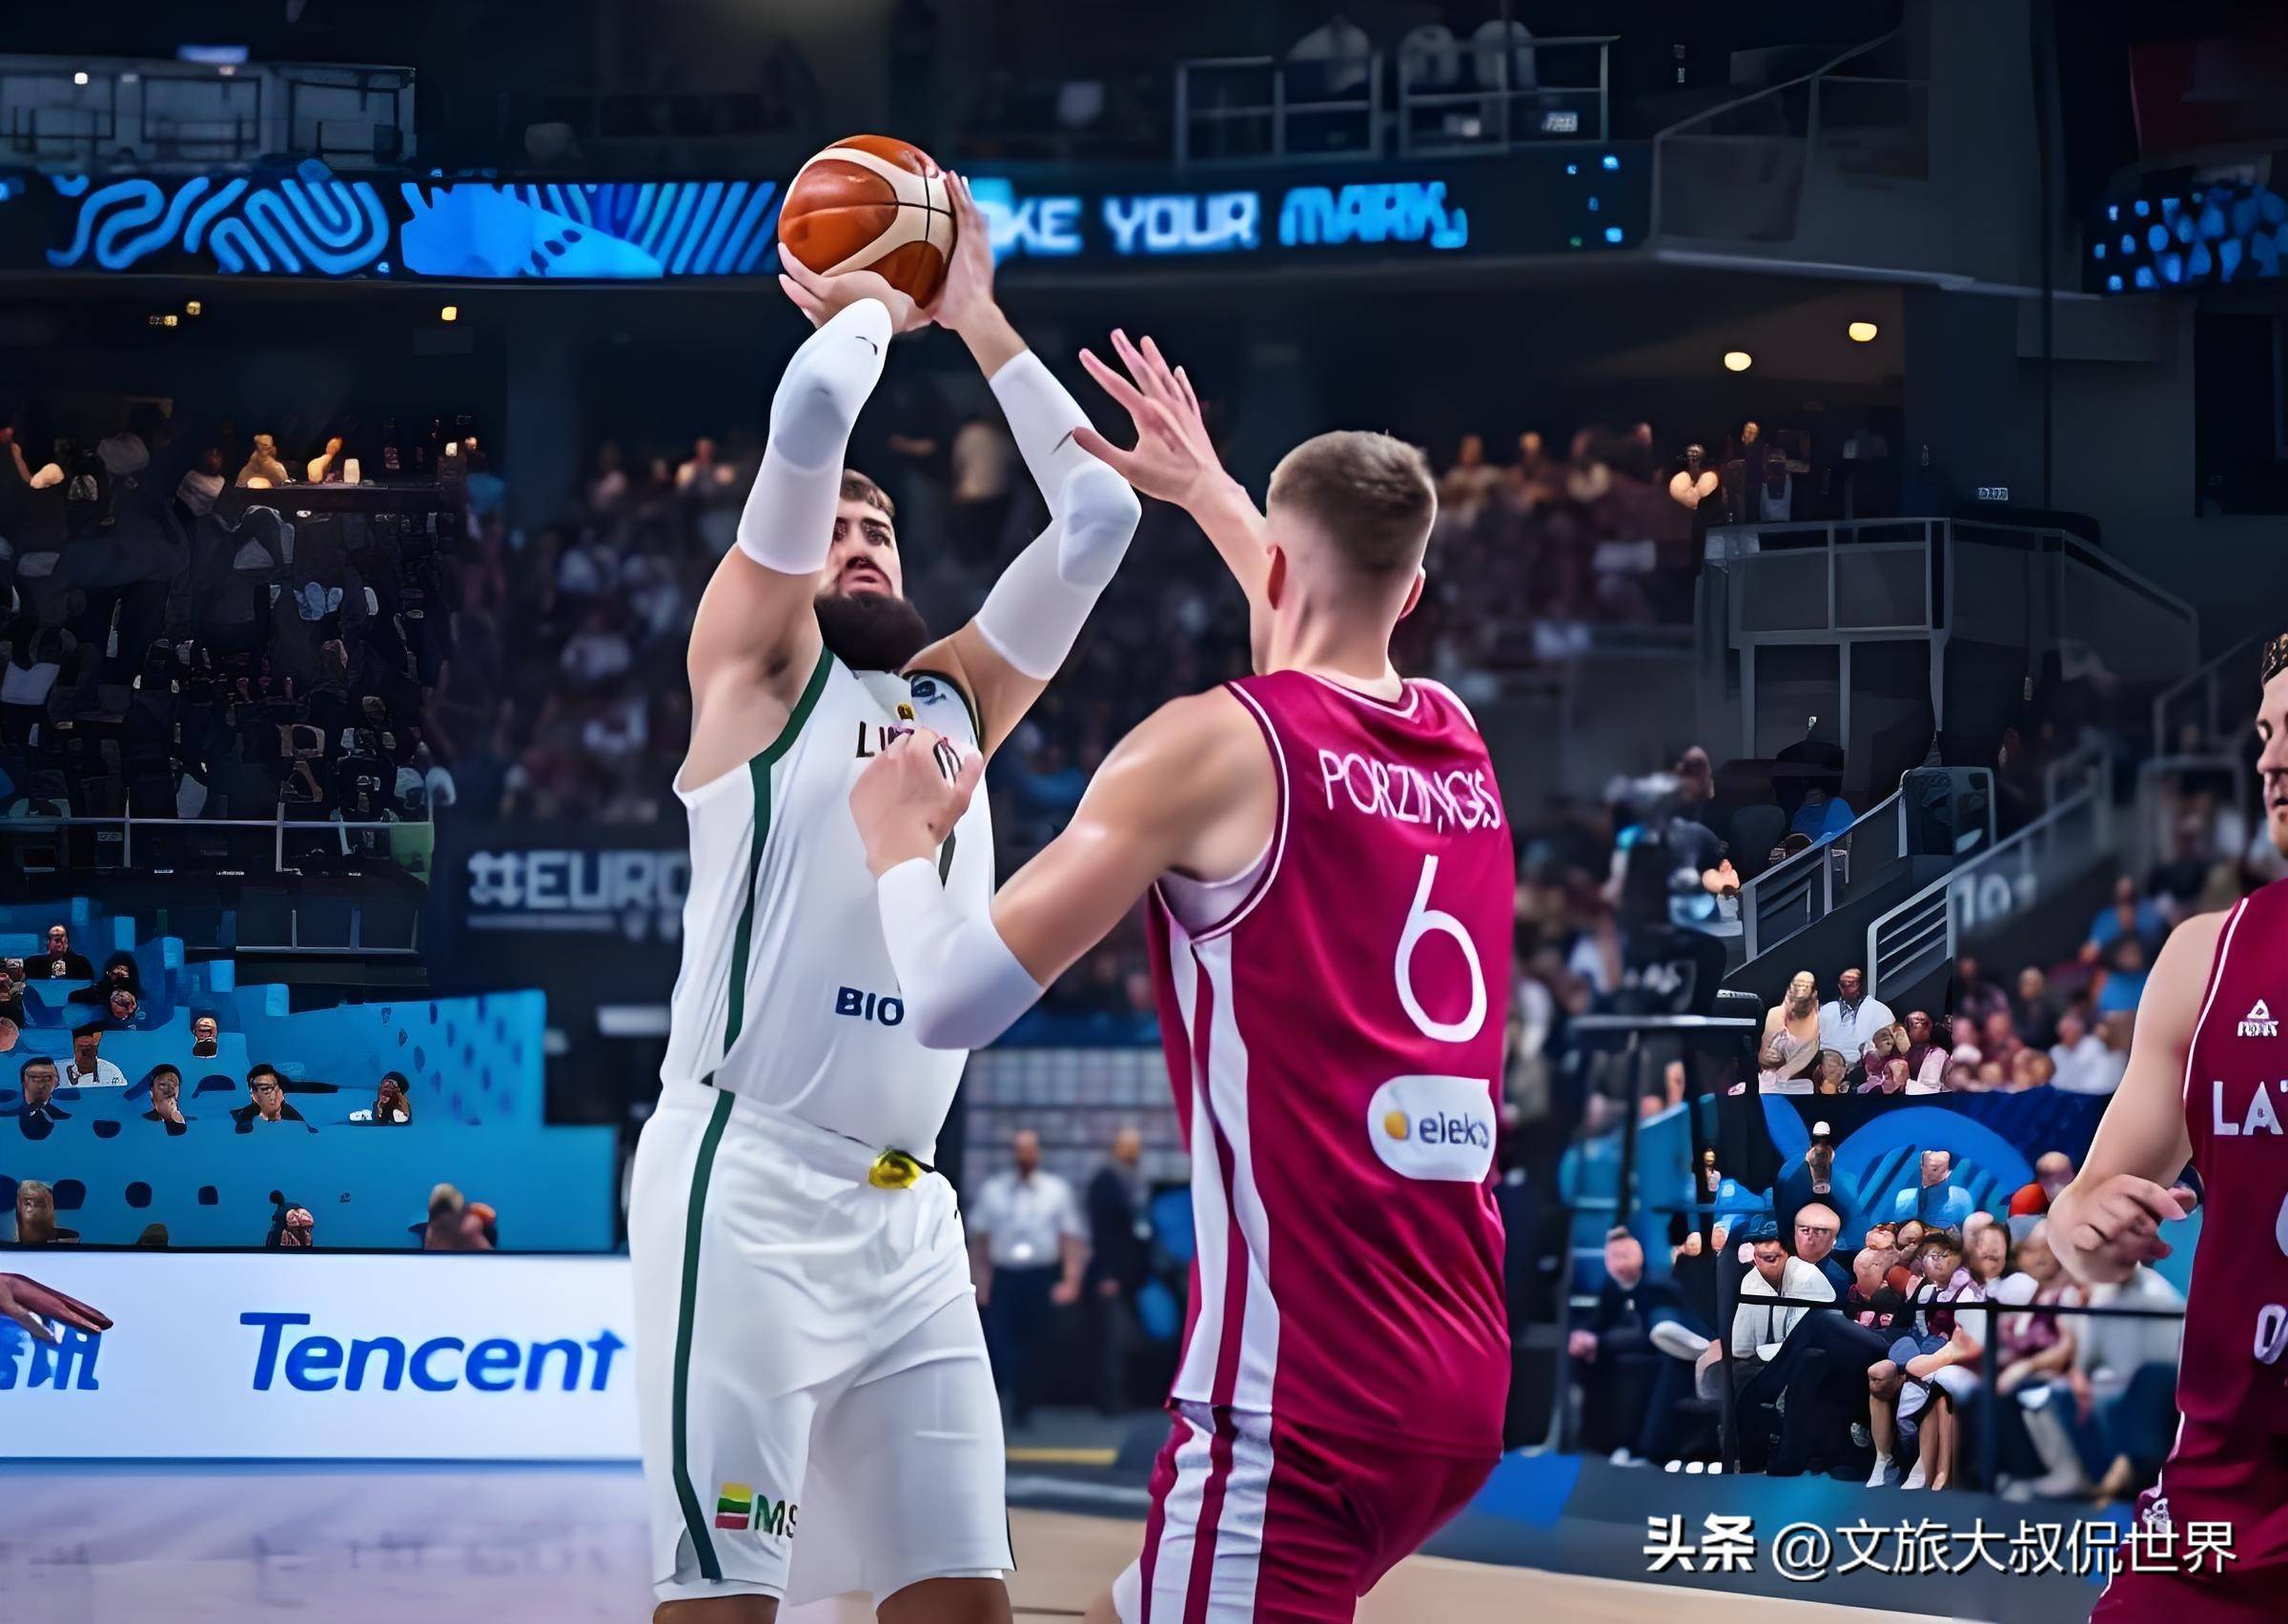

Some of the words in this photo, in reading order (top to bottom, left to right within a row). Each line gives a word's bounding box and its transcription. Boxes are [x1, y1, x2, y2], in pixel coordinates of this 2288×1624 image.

[1103, 193, 1260, 253] YOUR
[1278, 181, 1459, 248] MARK
[1395, 854, 1488, 1043] 6
[835, 985, 905, 1026] BIO
[240, 1311, 627, 1392] Tencent
